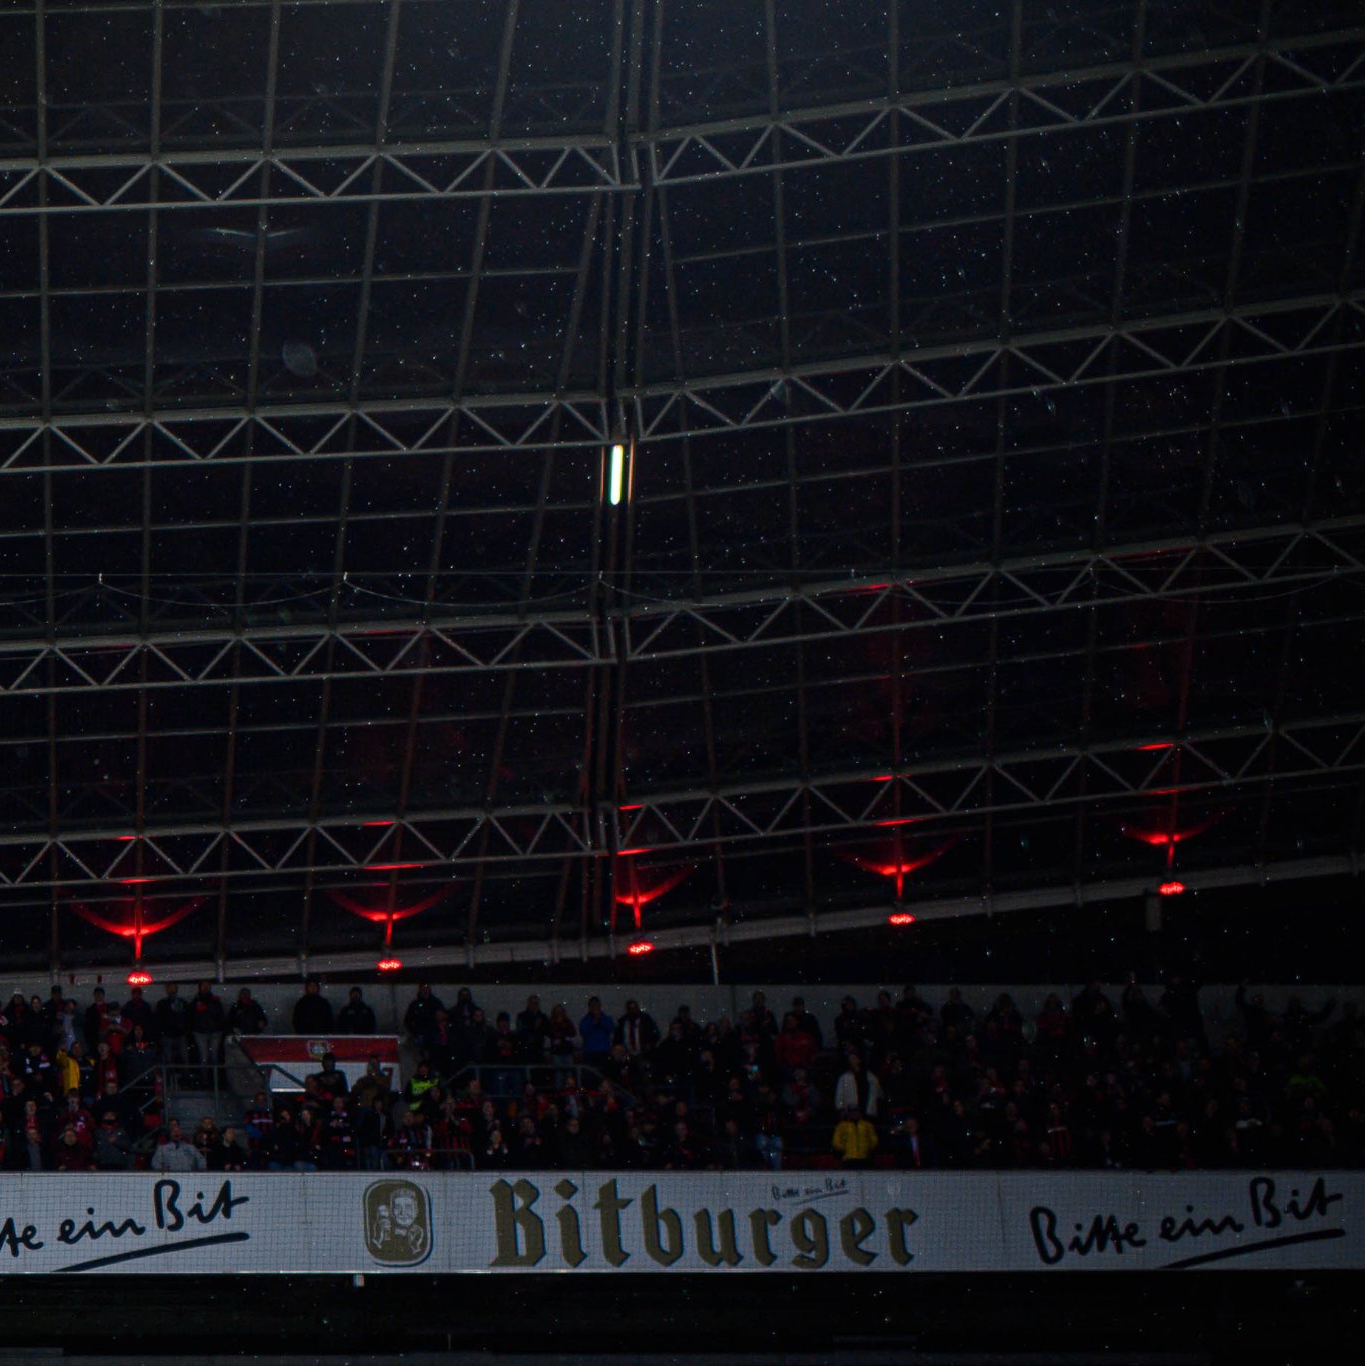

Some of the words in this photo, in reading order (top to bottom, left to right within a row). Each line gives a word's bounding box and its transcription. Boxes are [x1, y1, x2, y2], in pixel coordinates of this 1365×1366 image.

[56, 1205, 147, 1246] ein
[153, 1179, 250, 1232] Bit
[488, 1177, 919, 1268] Bitburger
[1030, 1206, 1147, 1265] Bitte
[1158, 1205, 1245, 1243] ein
[1249, 1177, 1344, 1229] Bit
